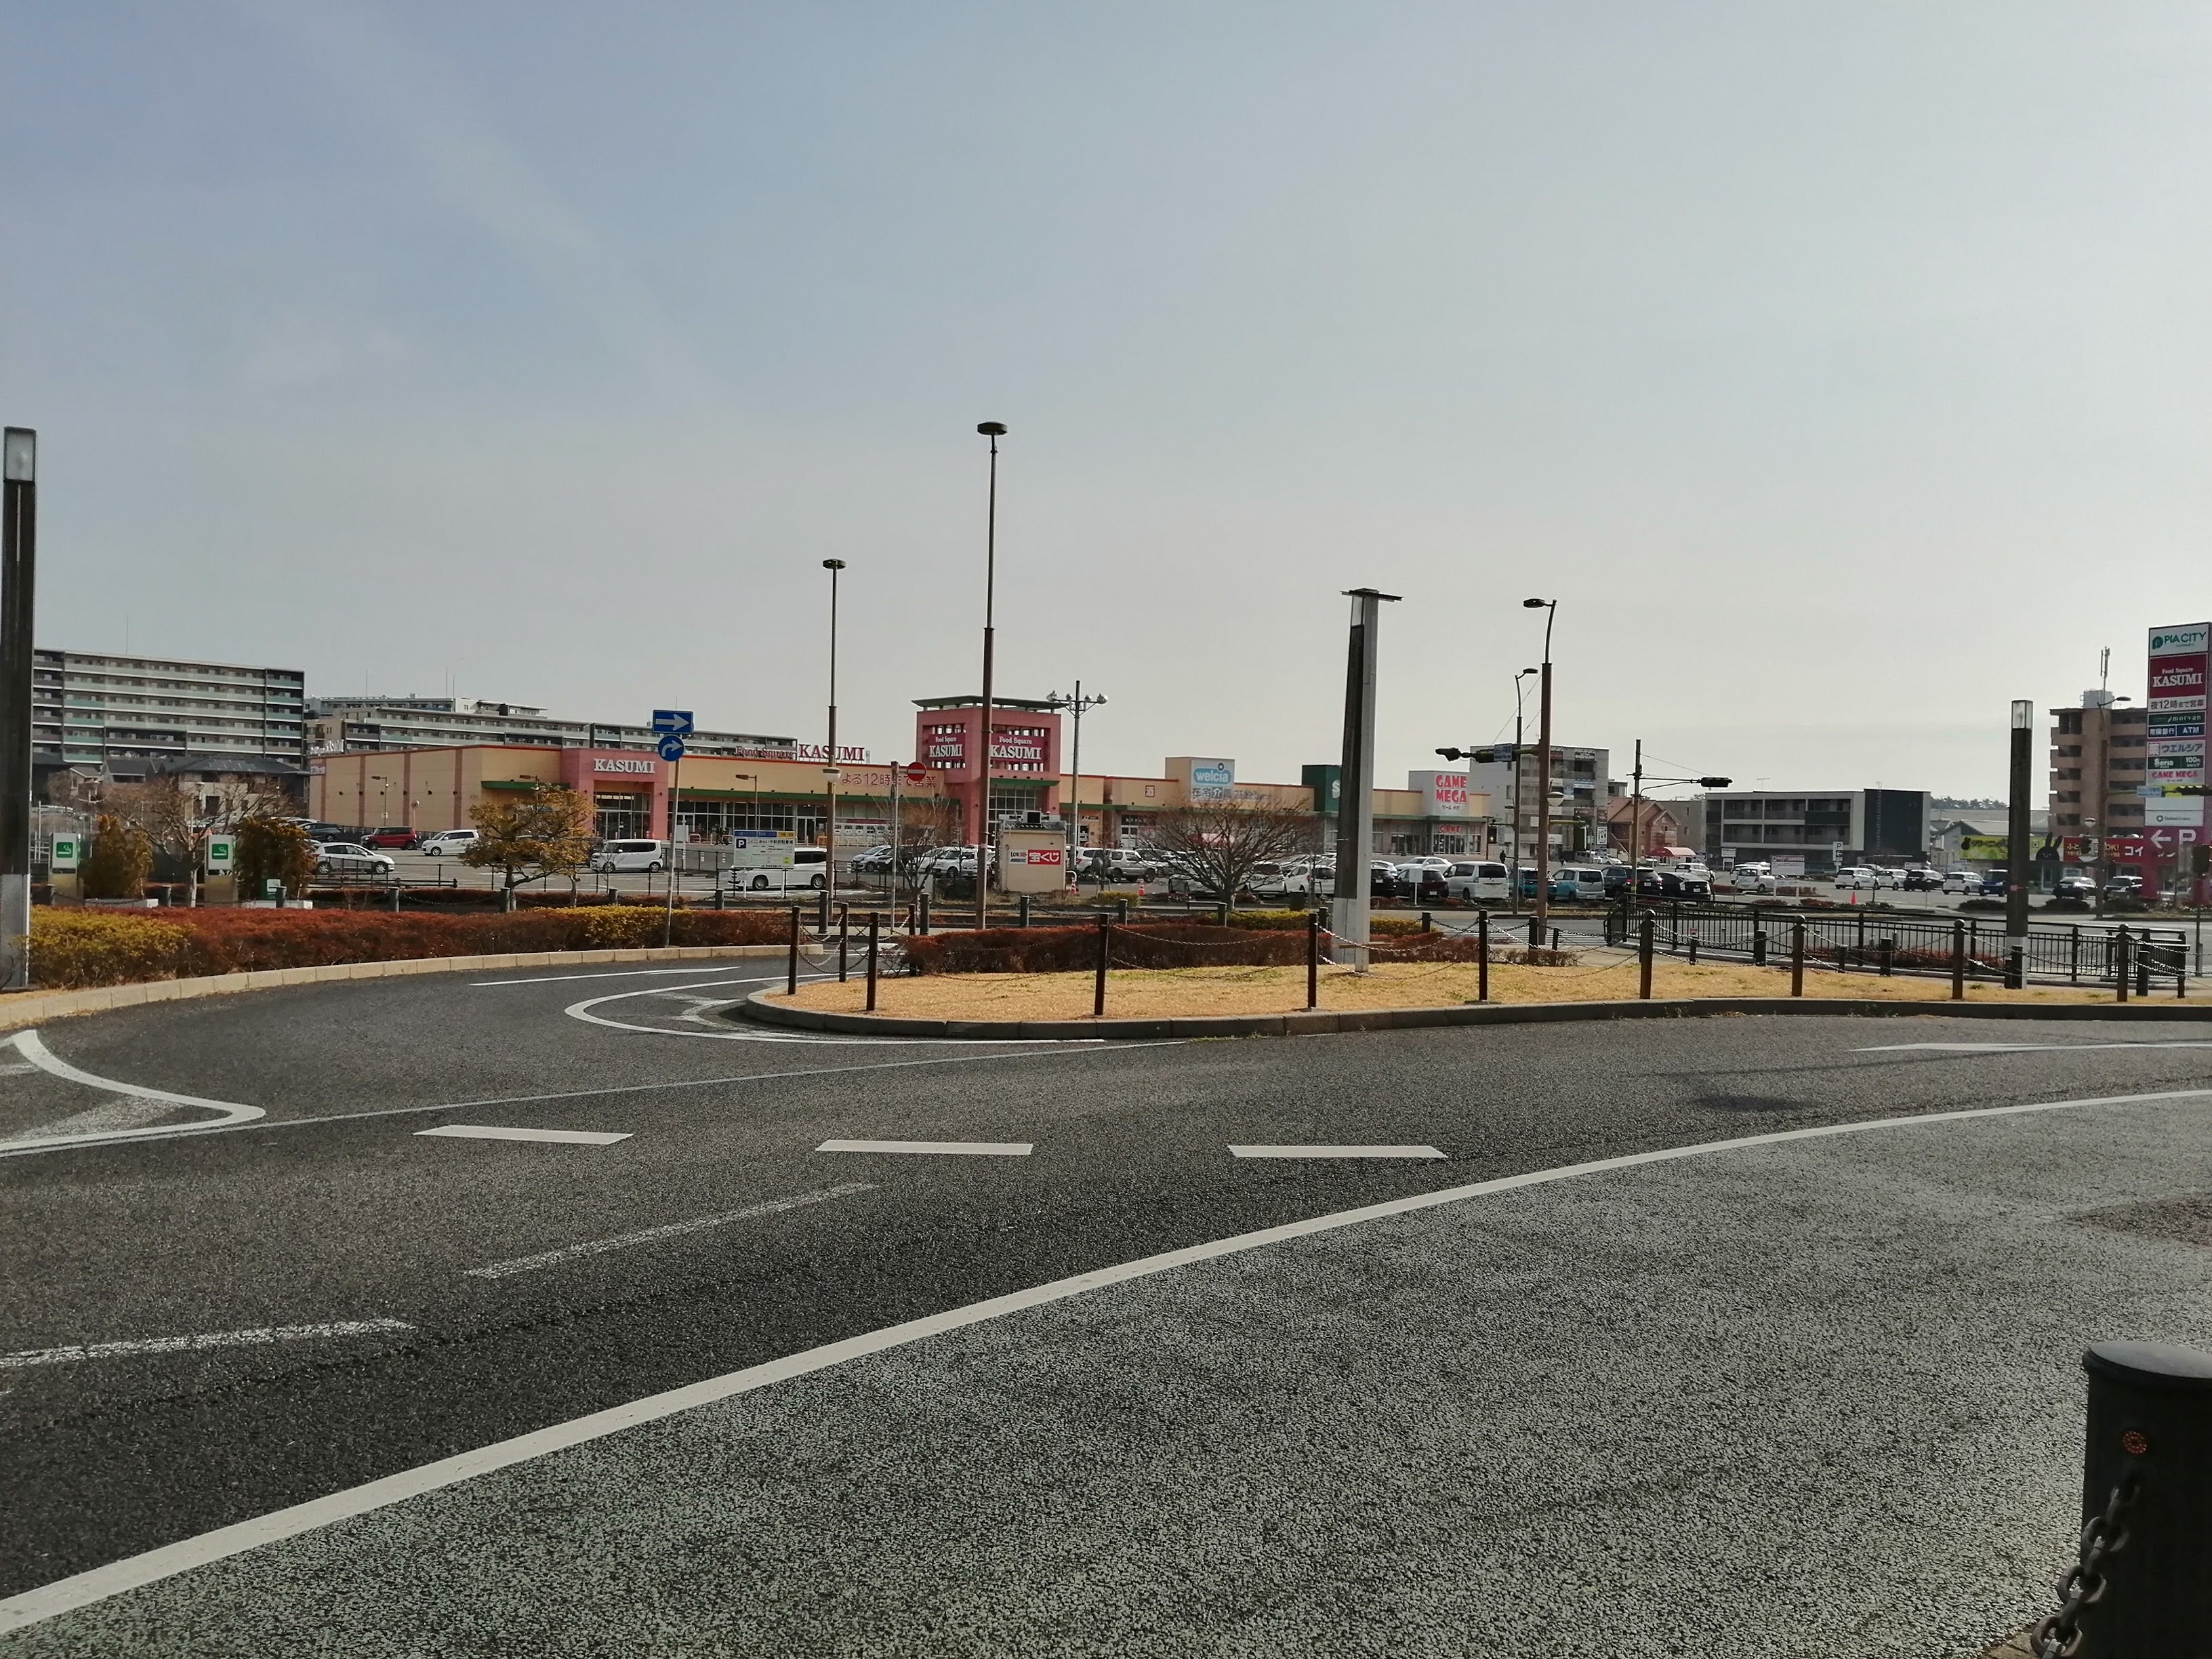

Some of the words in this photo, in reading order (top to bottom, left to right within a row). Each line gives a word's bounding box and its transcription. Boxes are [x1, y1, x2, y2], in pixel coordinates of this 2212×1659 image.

[2181, 632, 2207, 642] CITY
[2152, 673, 2203, 687] KASUMI
[999, 736, 1012, 744] Food
[1013, 737, 1033, 745] Square
[734, 745, 758, 758] Food
[760, 747, 794, 760] Square
[798, 743, 865, 761] KASUMI
[929, 744, 963, 758] KASUMI
[990, 744, 1042, 760] KASUMI
[2161, 743, 2203, 754] ウエルシア
[594, 758, 655, 774] KASUMI
[1195, 769, 1229, 783] welcia
[1435, 775, 1467, 788] GAME
[1435, 790, 1468, 803] MEGA
[738, 840, 745, 848] P
[2179, 829, 2196, 846] P
[1029, 851, 1060, 863] 宝くじ
[2125, 846, 2144, 857] コイ
